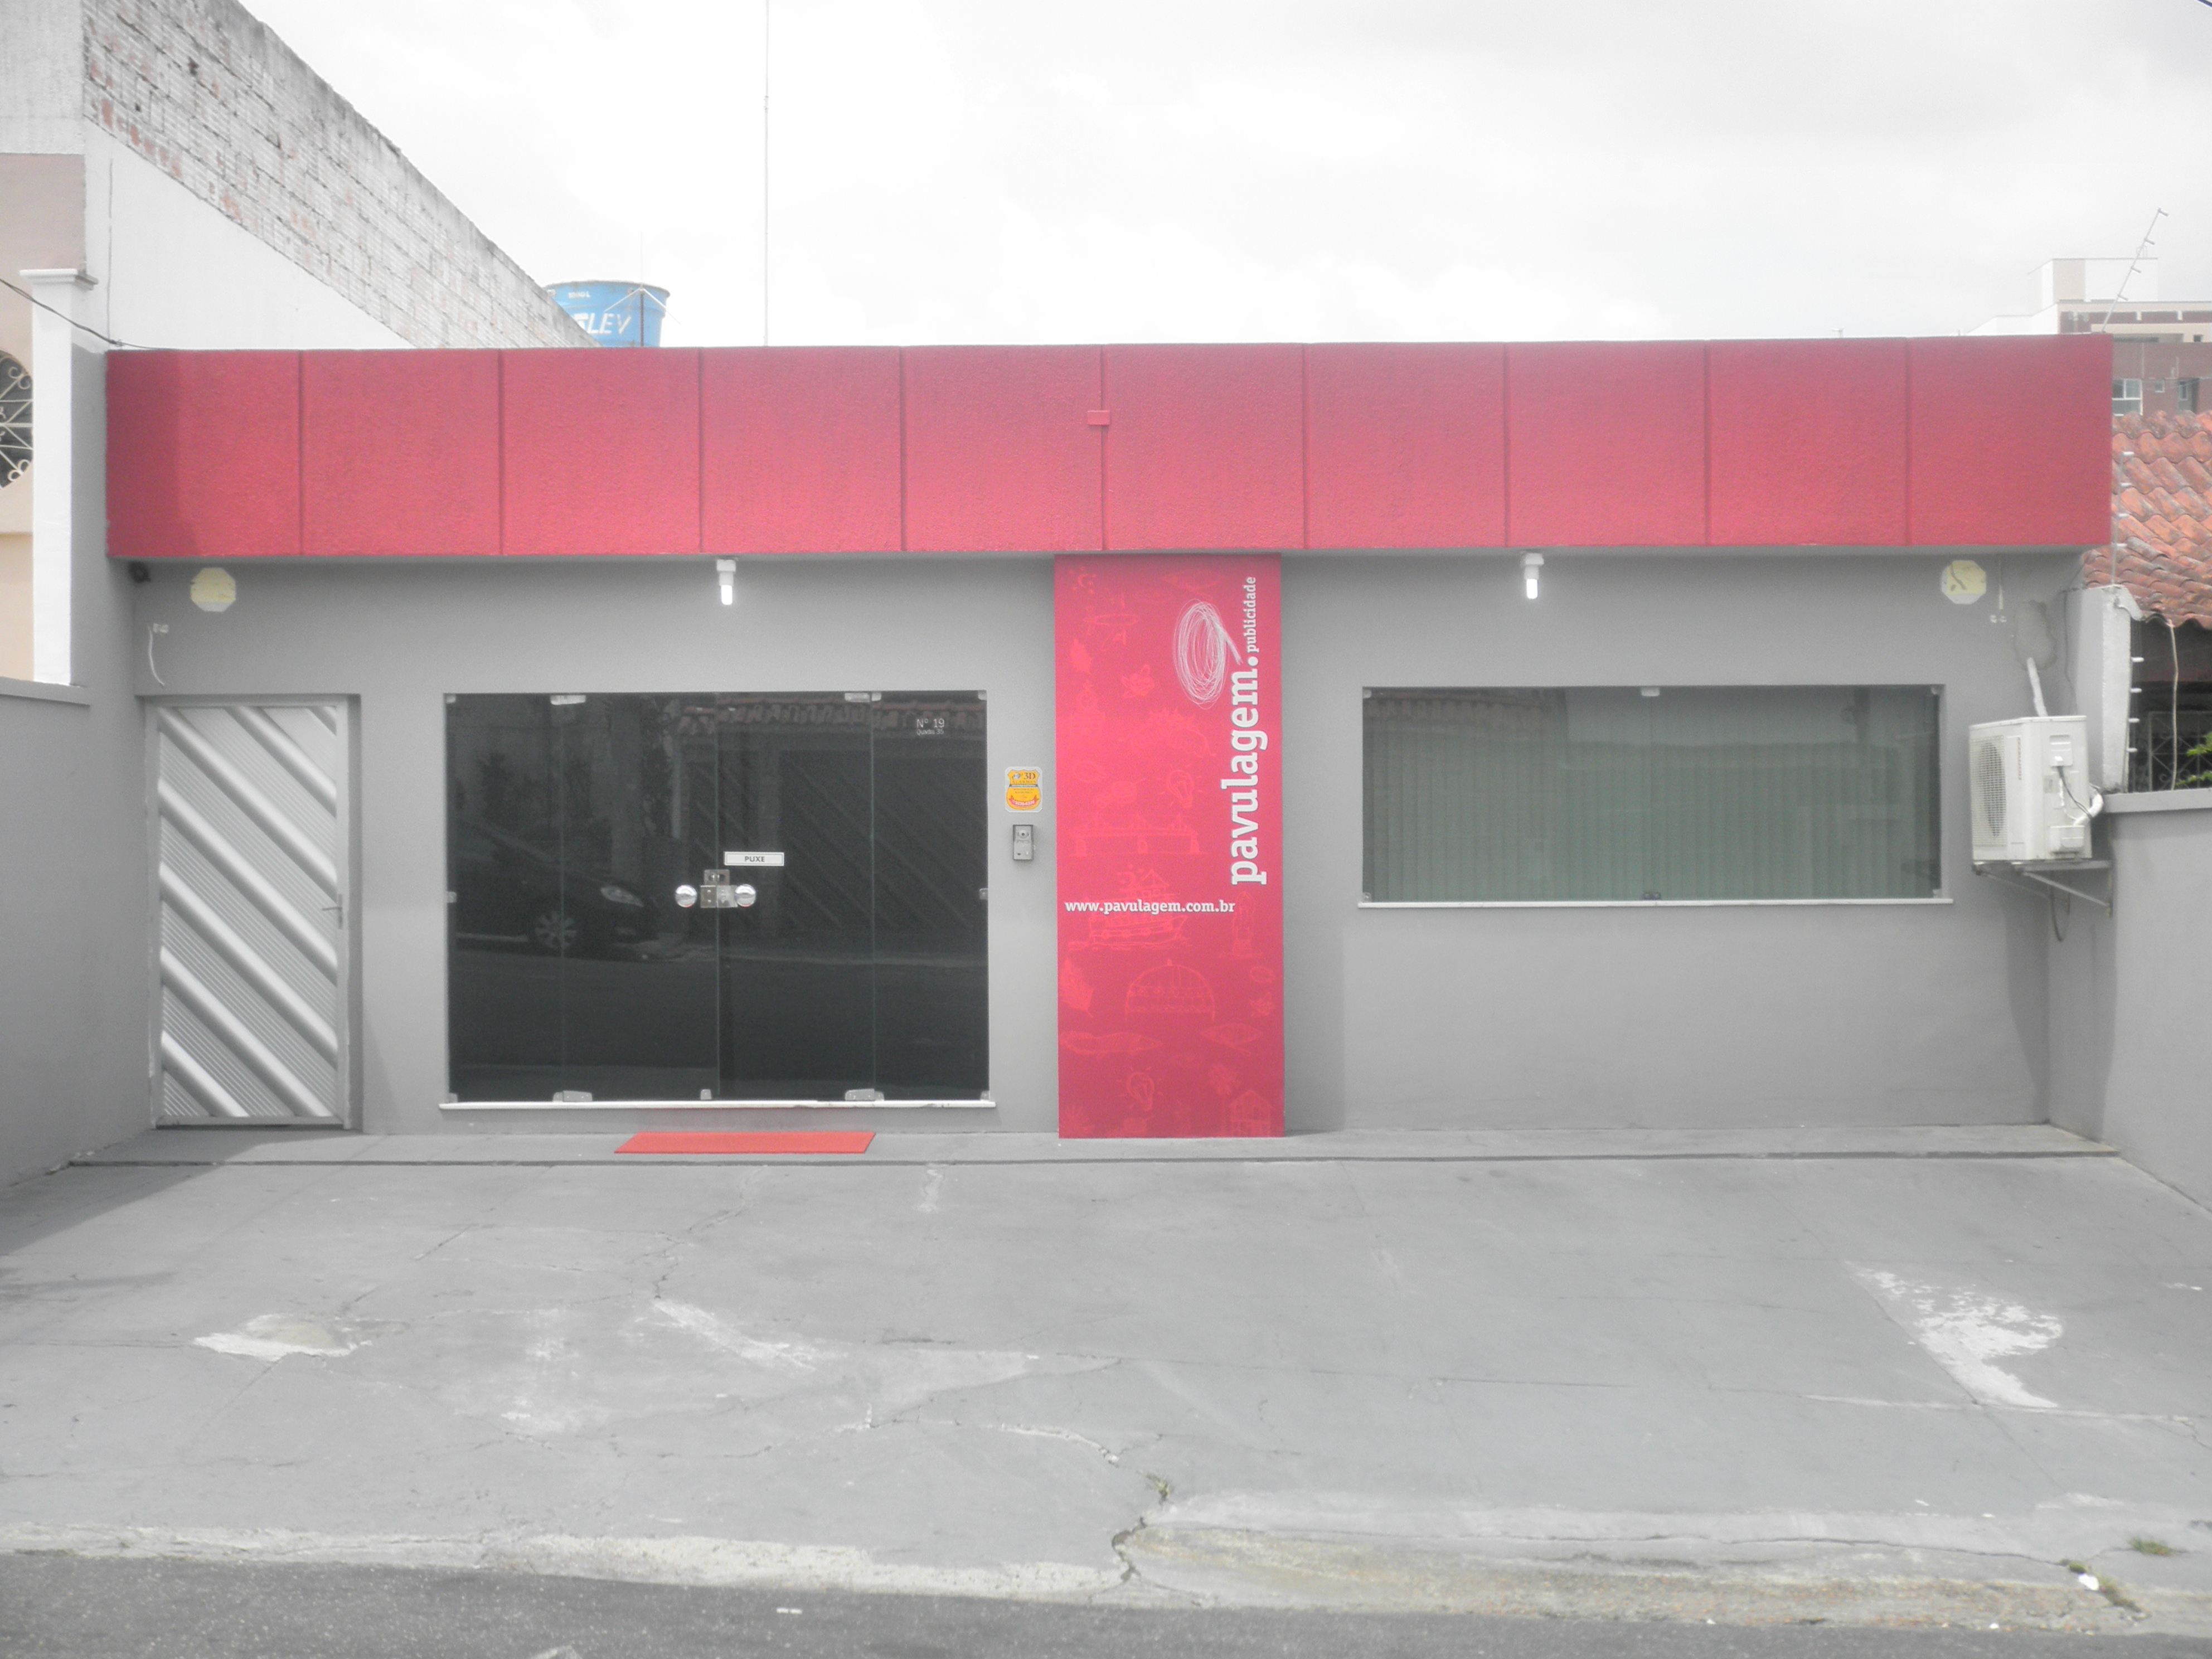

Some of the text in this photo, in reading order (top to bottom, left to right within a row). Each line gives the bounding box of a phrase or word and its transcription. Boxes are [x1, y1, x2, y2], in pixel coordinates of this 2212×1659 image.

[1243, 577, 1259, 653] publicidade
[933, 718, 945, 728] 19
[1065, 899, 1235, 915] www.pavulagem.com.br
